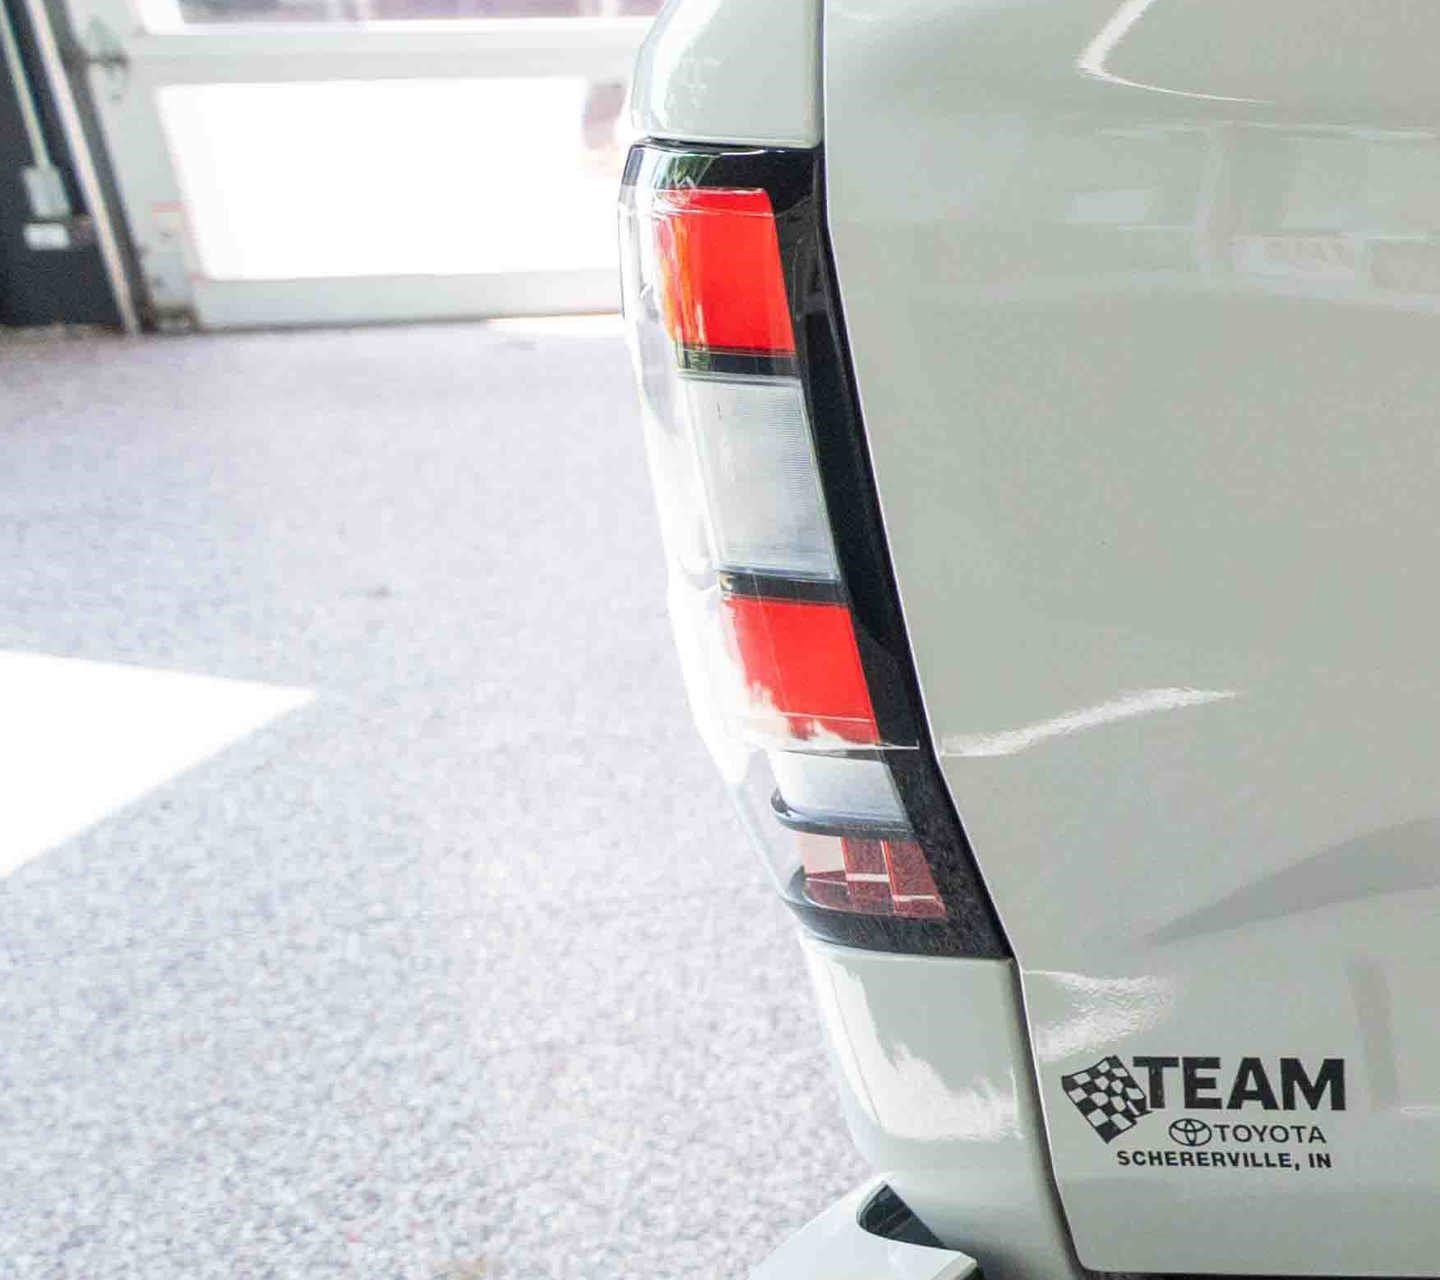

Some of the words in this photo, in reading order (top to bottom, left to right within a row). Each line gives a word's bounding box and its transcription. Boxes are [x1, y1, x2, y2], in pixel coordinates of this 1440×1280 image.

[1132, 1056, 1346, 1111] TEAM
[1214, 1123, 1327, 1144] TOYOTA
[1116, 1150, 1300, 1171] SCHERERVILLE,
[1308, 1152, 1332, 1168] IN
